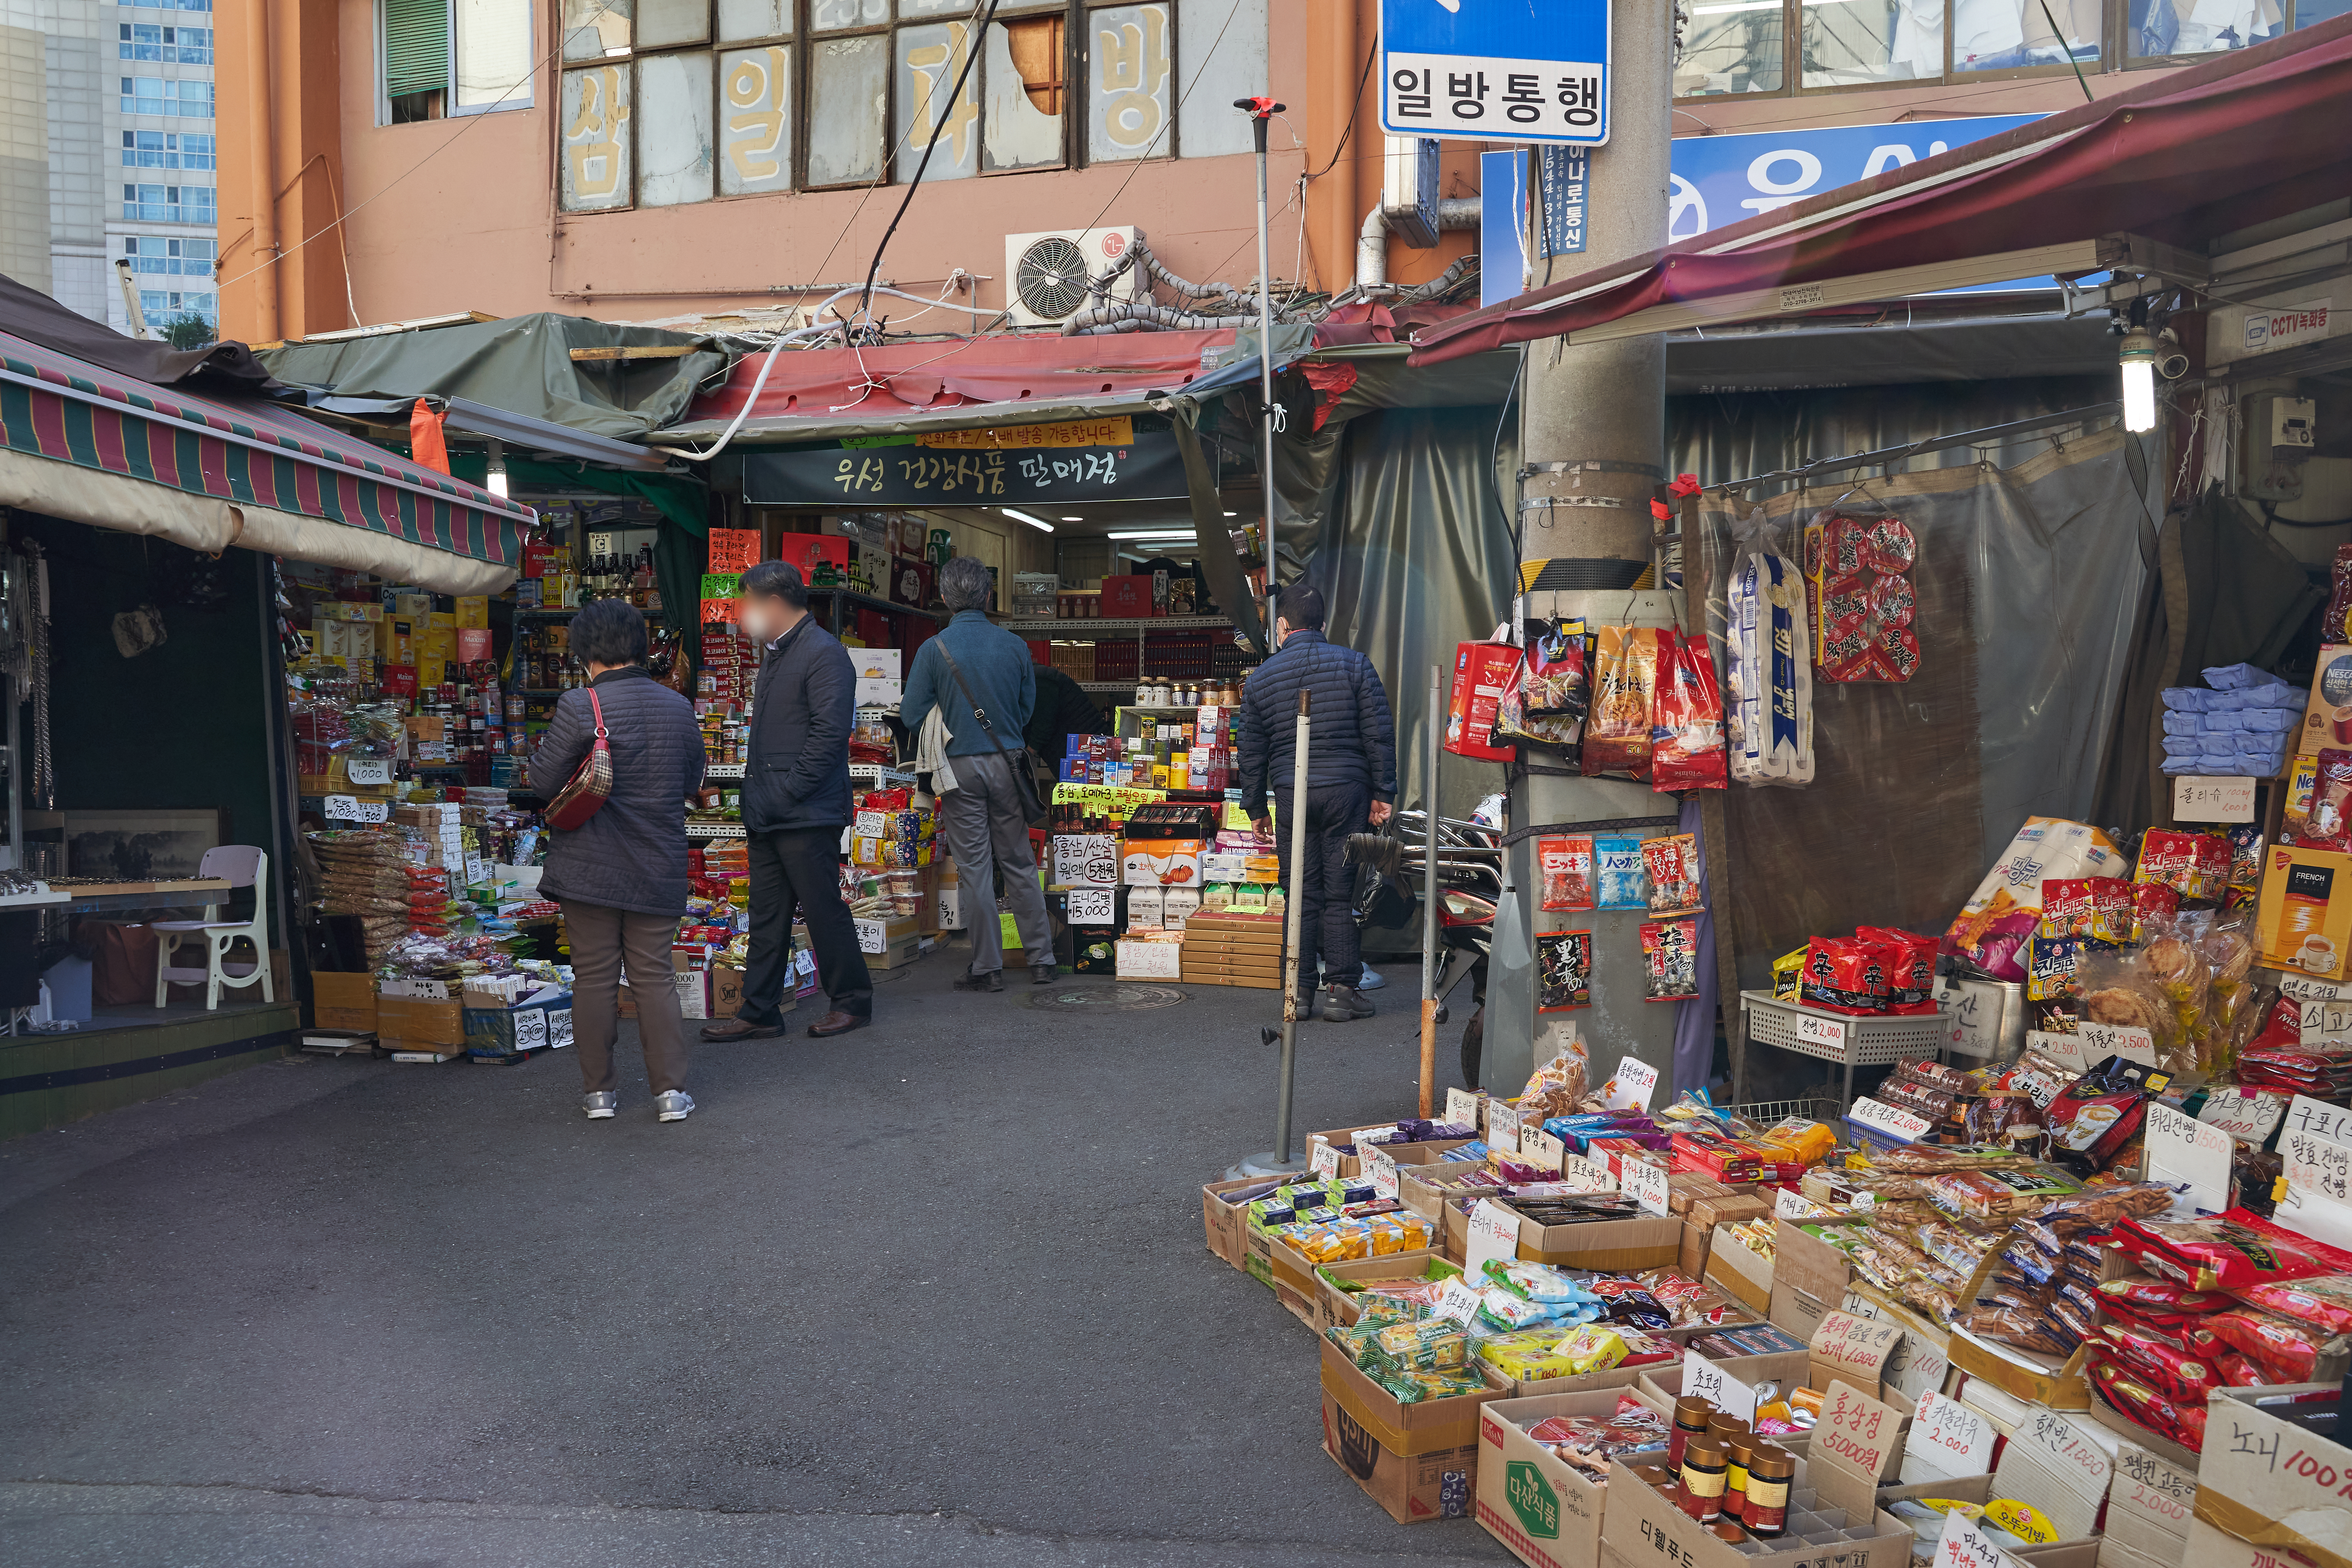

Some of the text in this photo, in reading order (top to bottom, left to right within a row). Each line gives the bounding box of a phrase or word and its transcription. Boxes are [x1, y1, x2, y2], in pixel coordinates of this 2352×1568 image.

[1392, 68, 1598, 126] 일방통행
[1784, 297, 1821, 307] 010-2798-3914
[2271, 307, 2327, 337] CCTV녹화중
[834, 451, 1117, 494] 우성 건강식품 판매점
[704, 575, 736, 587] 건강기능
[464, 636, 486, 644] Maxim
[1454, 672, 1466, 685] COFFEE
[2326, 679, 2348, 688] 신선한
[1665, 687, 1708, 702] 커피믹스
[1501, 719, 1515, 731] 50
[1626, 744, 1643, 756] 50
[2325, 780, 2342, 789] 초이스
[1116, 789, 1149, 803] 크릴오일
[2180, 787, 2221, 803] 물티슈
[1059, 862, 1116, 880] 원액 5천원
[2007, 856, 2043, 886] 땡큐
[2145, 852, 2189, 875] 진라면
[2296, 872, 2325, 881] FRENCH
[1072, 892, 1111, 906] 노니 2병
[2096, 892, 2129, 916] 진라면
[2047, 897, 2085, 924] 진라면
[1118, 959, 1169, 974] 파스 천원
[1812, 950, 1835, 991] 辛
[1911, 959, 1931, 991] 辛
[2036, 957, 2075, 981] 진라면
[2327, 961, 2340, 971] 300
[415, 982, 433, 993] 사탕
[1777, 982, 1795, 993] HANA
[1864, 963, 1884, 997] 辛
[2283, 980, 2338, 999] 맥심 커피
[518, 1013, 537, 1024] 세안비누
[1819, 1023, 1841, 1039] 2,000
[2085, 1030, 2116, 1049] 누룽지
[1456, 1111, 1468, 1121] 500
[1491, 1105, 1515, 1125] LG 페리오
[1523, 1127, 1539, 1146] 양갱
[1361, 1146, 1376, 1164] 무궁화
[2290, 1135, 2320, 1167] 발효
[1364, 1162, 1374, 1176] 3개
[1571, 1159, 1607, 1189] 초코바 3개
[1628, 1182, 1641, 1197] 2개
[1832, 1193, 1848, 1203] IMPERIAL
[1856, 1194, 1875, 1207] 라면
[1820, 1315, 1851, 1340] 롯데
[1848, 1324, 1873, 1343] 음료
[1819, 1341, 1847, 1363] 3개
[1598, 1351, 1613, 1372] Kid-O
[1541, 1368, 1557, 1380] Kid-O
[1693, 1368, 1722, 1401] 초코릿
[1829, 1392, 1883, 1441] 홍삼정
[1483, 1422, 1503, 1444] DASAN
[2032, 1414, 2068, 1453] 햇반
[1823, 1431, 1880, 1477] 5000원
[2230, 1421, 2280, 1474] 노니
[1510, 1476, 1556, 1530] 다산식품
[1568, 1488, 1584, 1503] 선물하는
[1997, 1512, 2047, 1543] 오뚜기밥
